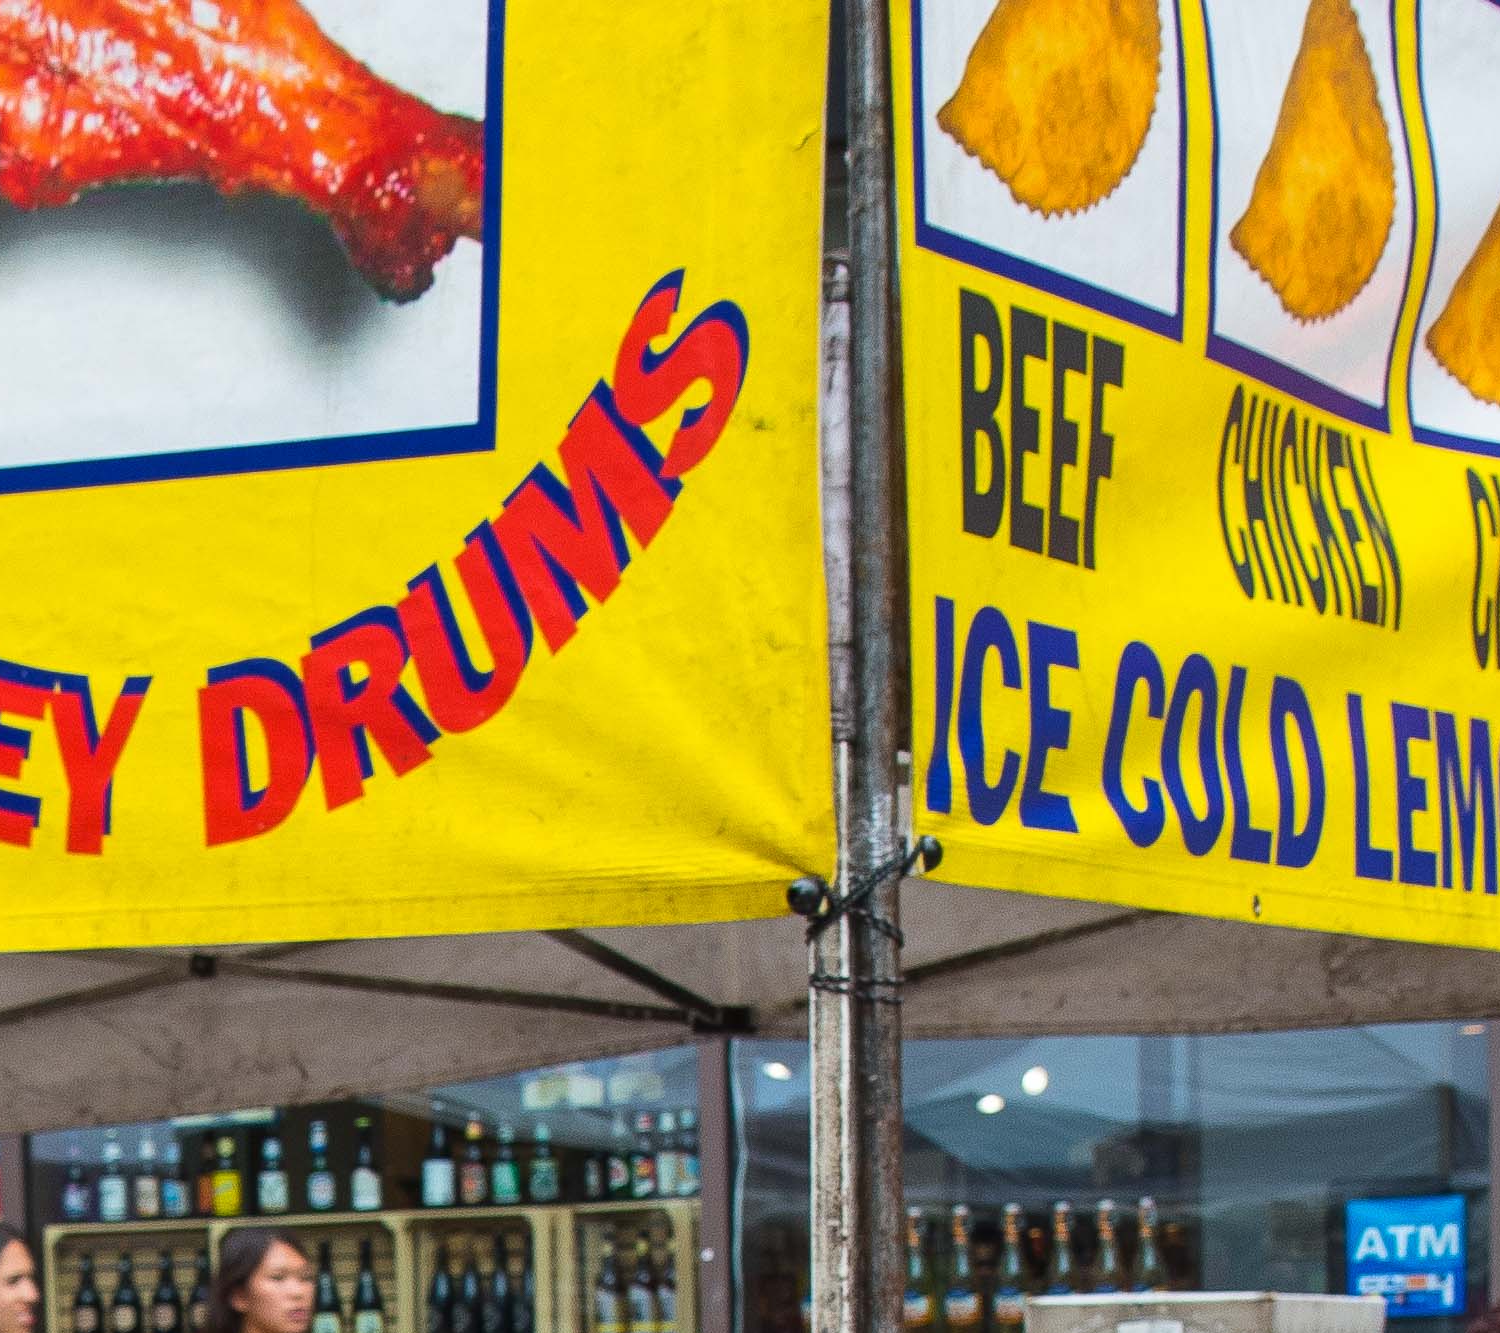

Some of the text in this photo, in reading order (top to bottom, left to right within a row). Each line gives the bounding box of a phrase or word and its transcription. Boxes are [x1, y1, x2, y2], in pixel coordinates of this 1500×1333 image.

[198, 267, 750, 847] DRUMS
[959, 288, 1125, 571] BEEF
[1216, 382, 1402, 631] CHICKEN
[926, 596, 1080, 833] ICE
[1102, 640, 1325, 870] COLD
[1354, 1223, 1461, 1261] ATM
